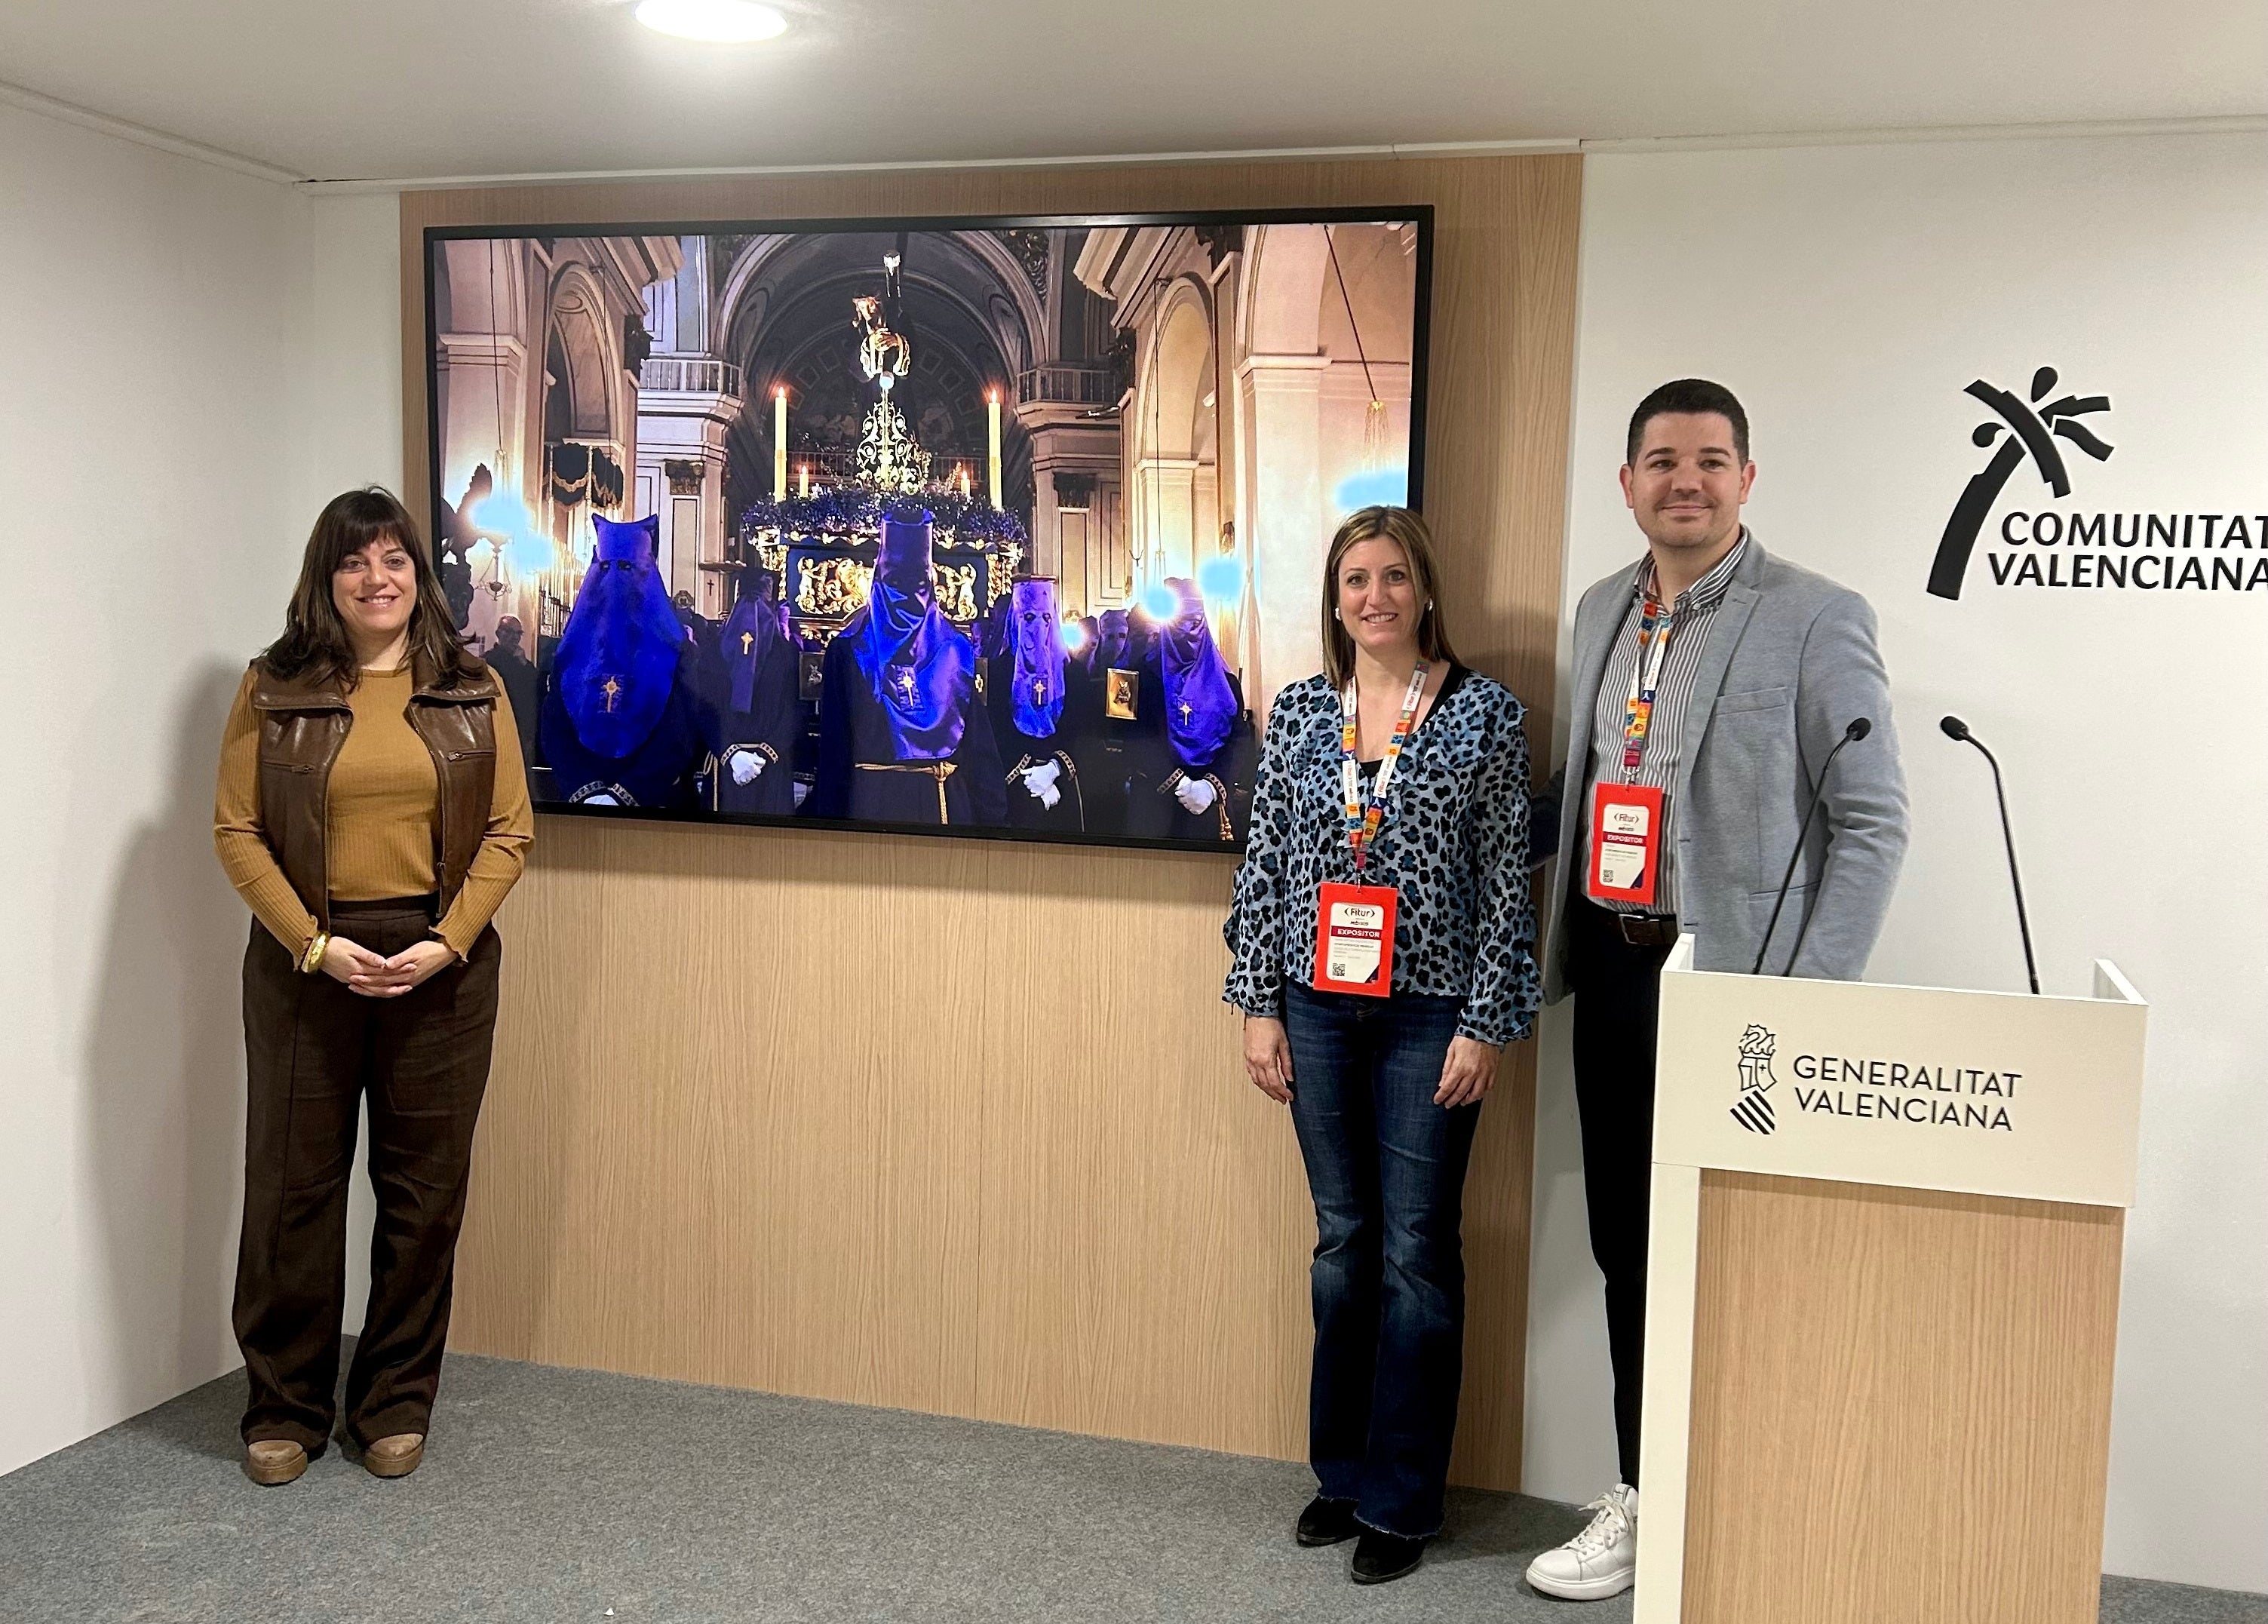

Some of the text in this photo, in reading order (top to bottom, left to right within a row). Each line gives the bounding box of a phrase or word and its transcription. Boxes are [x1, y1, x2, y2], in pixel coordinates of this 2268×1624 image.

[2002, 511, 2268, 549] COMUNITAT
[1987, 552, 2268, 591] VALENCIANA
[1350, 907, 1370, 917] Fitur
[1337, 929, 1380, 938] EXPOSITOR
[1793, 1055, 2023, 1098] GENERALITAT
[1794, 1087, 2013, 1131] VALENCIANA
